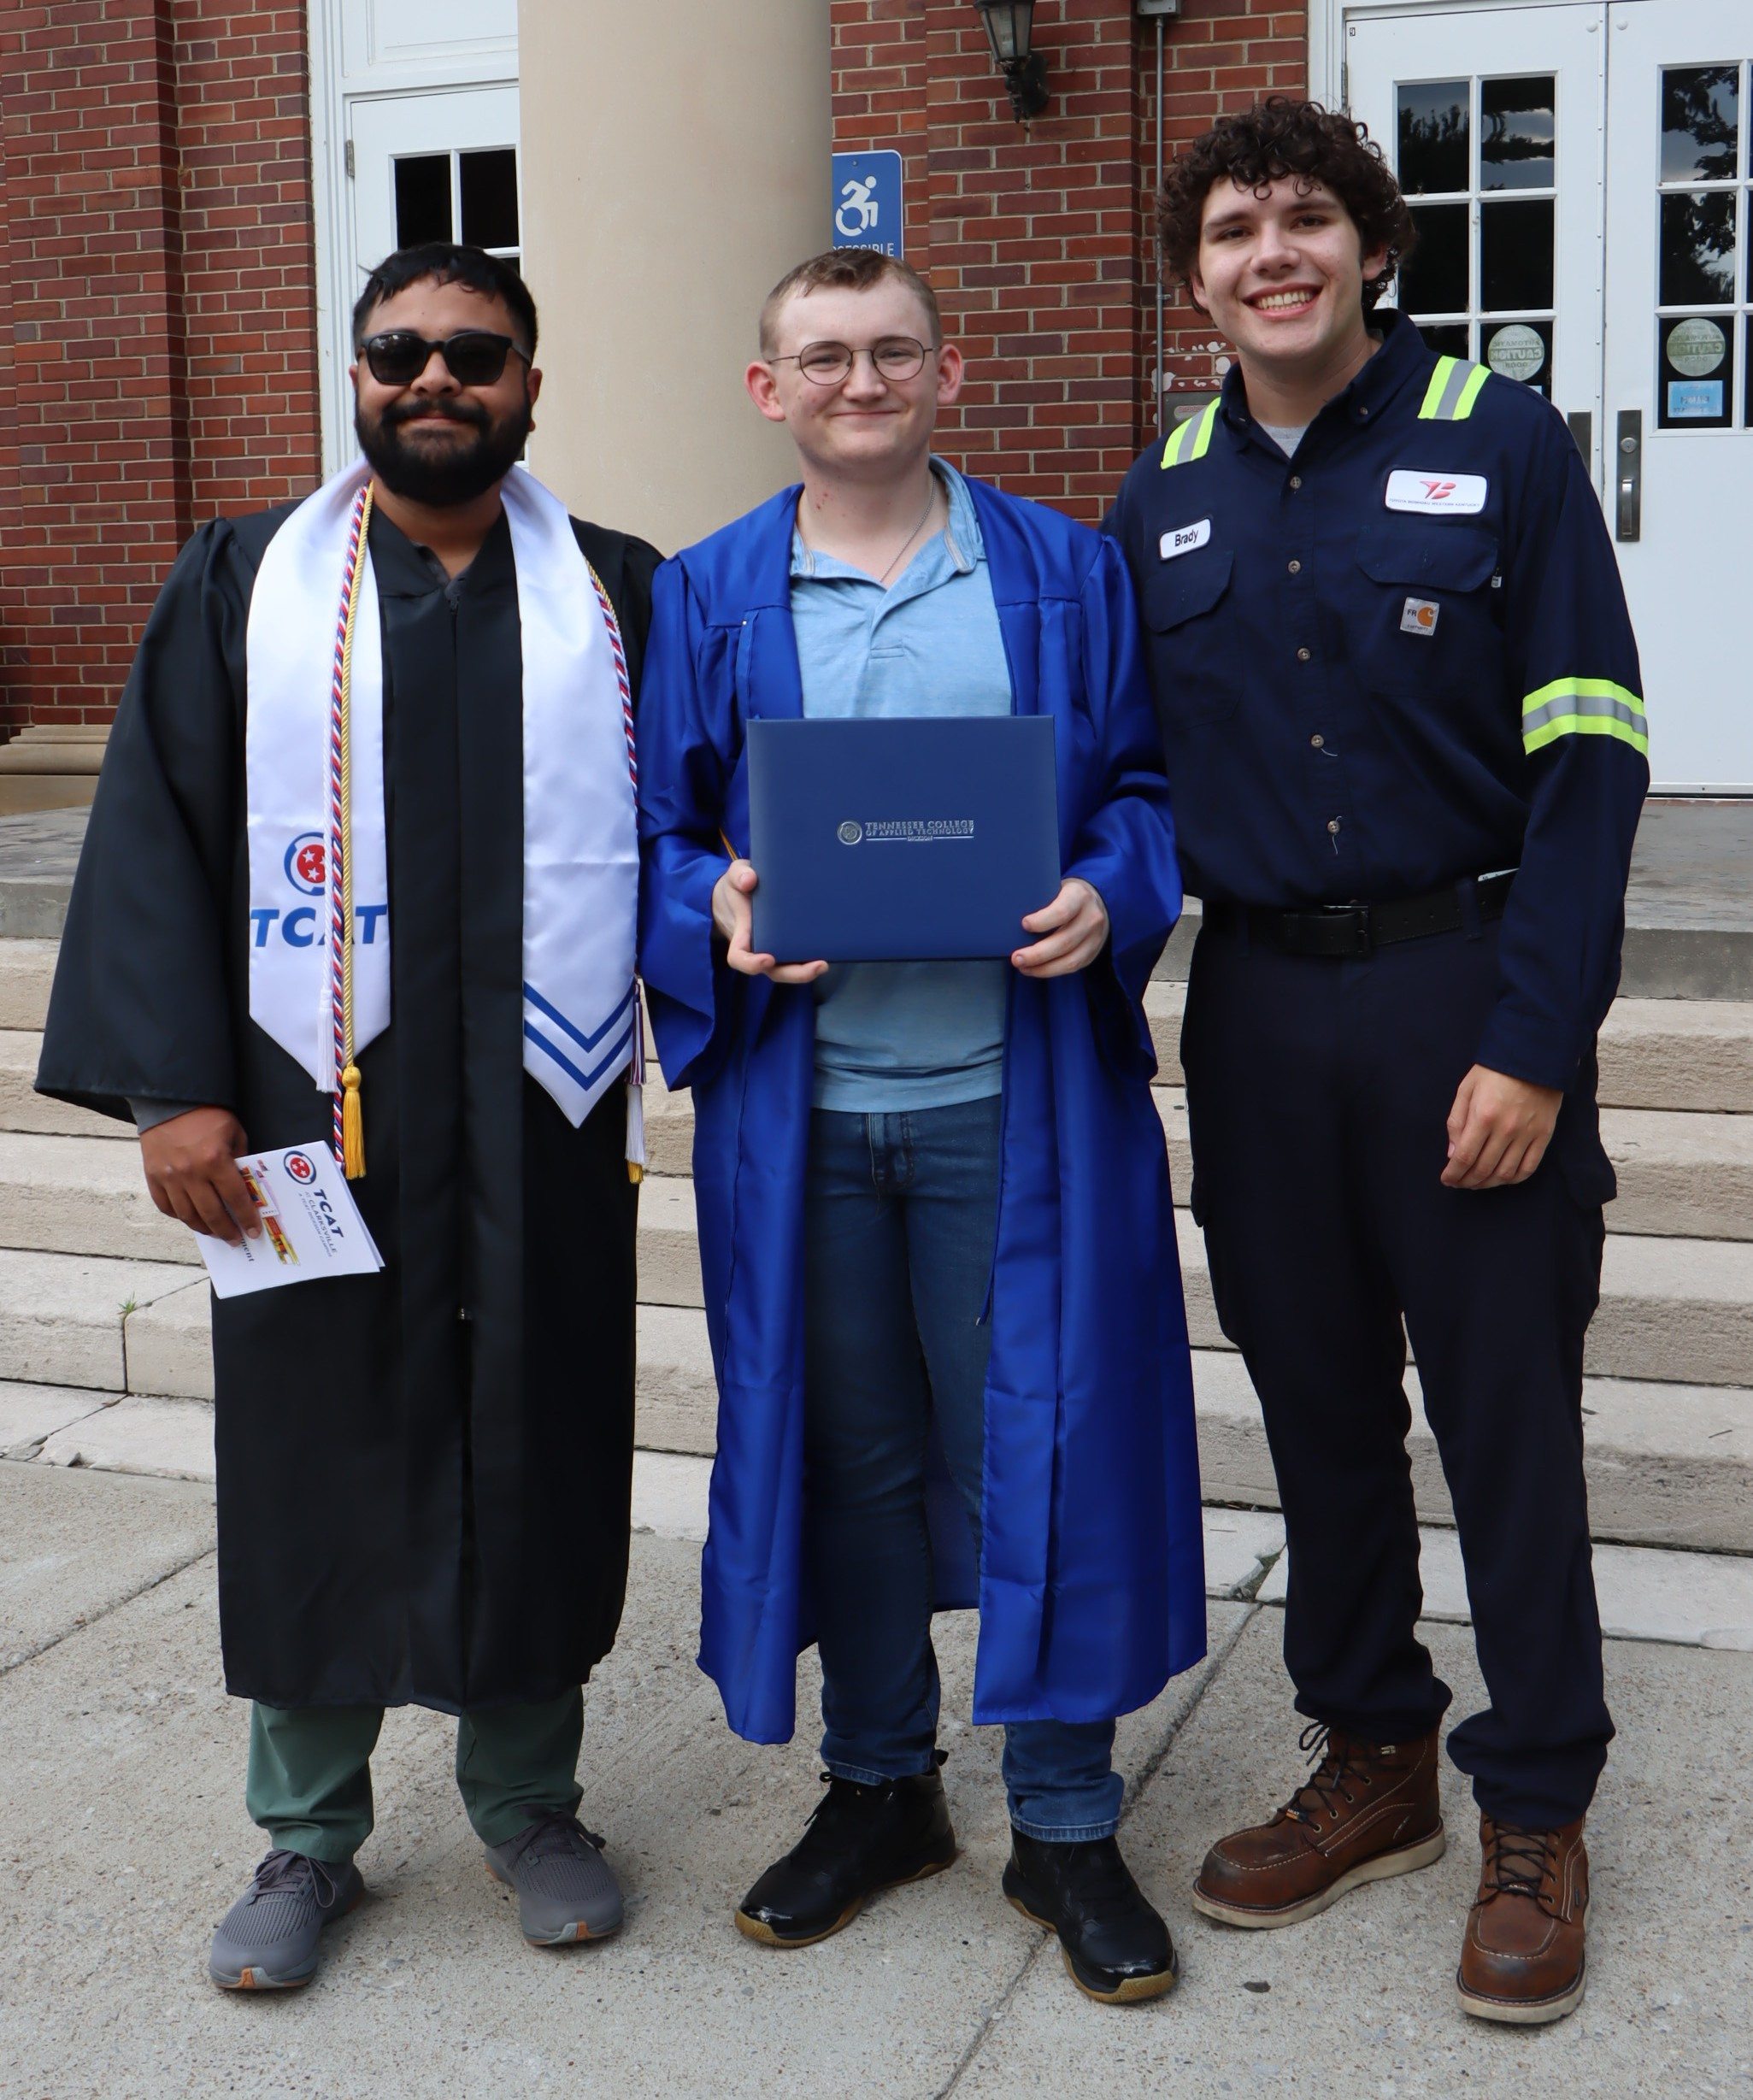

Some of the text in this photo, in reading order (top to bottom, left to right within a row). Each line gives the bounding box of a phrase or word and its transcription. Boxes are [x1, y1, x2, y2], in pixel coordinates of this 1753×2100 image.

[1174, 529, 1198, 547] Brady
[1407, 609, 1417, 617] FR
[865, 820, 974, 830] TENNESSEE COLLEGE
[250, 904, 388, 948] TCT
[309, 1199, 338, 1253] CLARKSVILLE
[314, 1189, 344, 1238] TCAT
